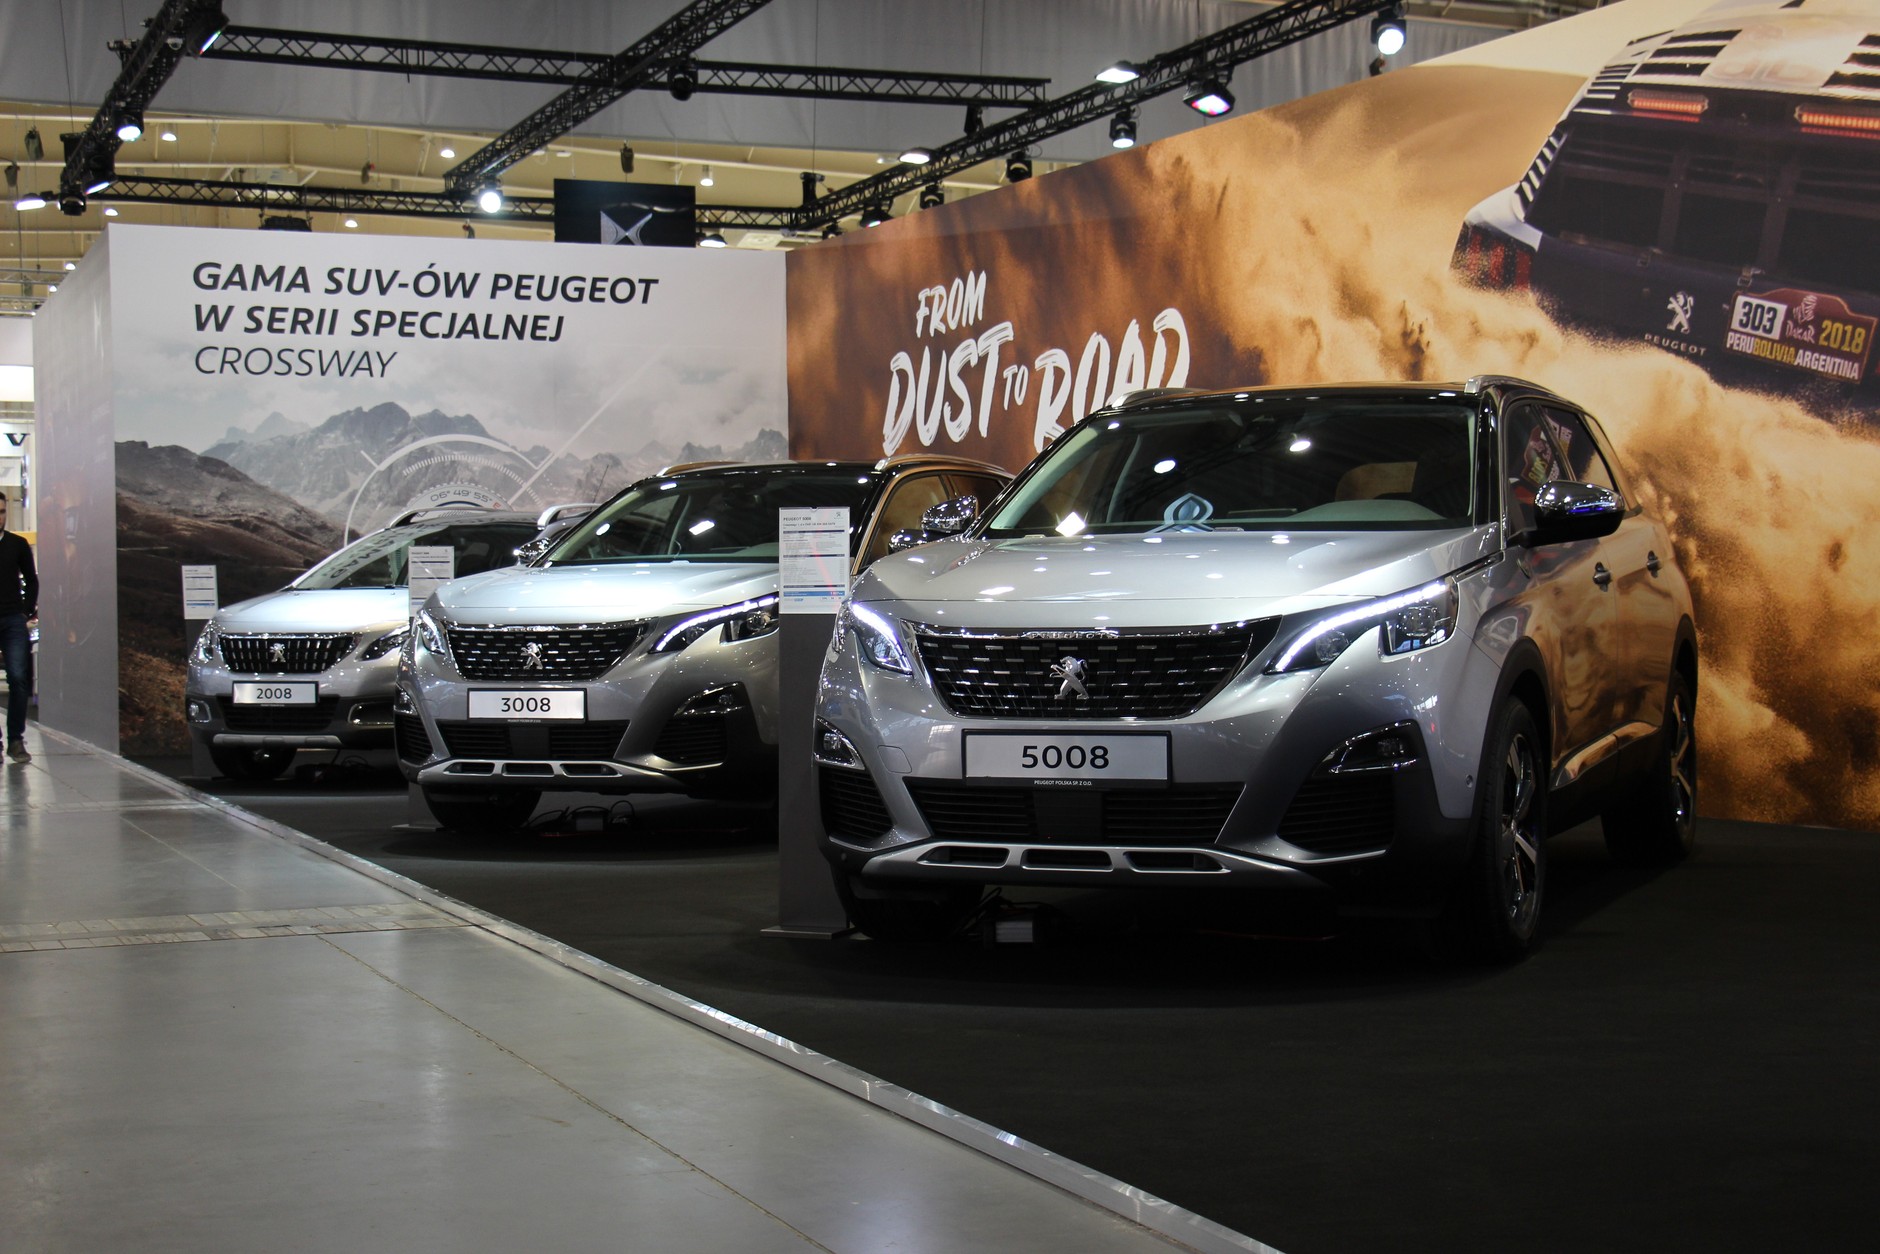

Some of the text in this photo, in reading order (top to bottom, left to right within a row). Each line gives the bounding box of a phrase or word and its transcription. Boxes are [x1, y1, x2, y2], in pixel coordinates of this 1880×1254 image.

[193, 262, 659, 305] GAMA SUV-ÓW PEUGEOT
[916, 270, 987, 338] FROM
[1738, 301, 1777, 335] 303
[194, 304, 565, 342] W SERII SPECJALNEJ
[1818, 319, 1866, 355] 2018
[194, 346, 398, 378] CROSSWAY
[1644, 333, 1707, 357] PEUGEOT
[882, 308, 1190, 457] DUST TO ROAD
[256, 687, 293, 700] 2008
[501, 697, 551, 712] 3008
[1021, 745, 1110, 769] 5008
